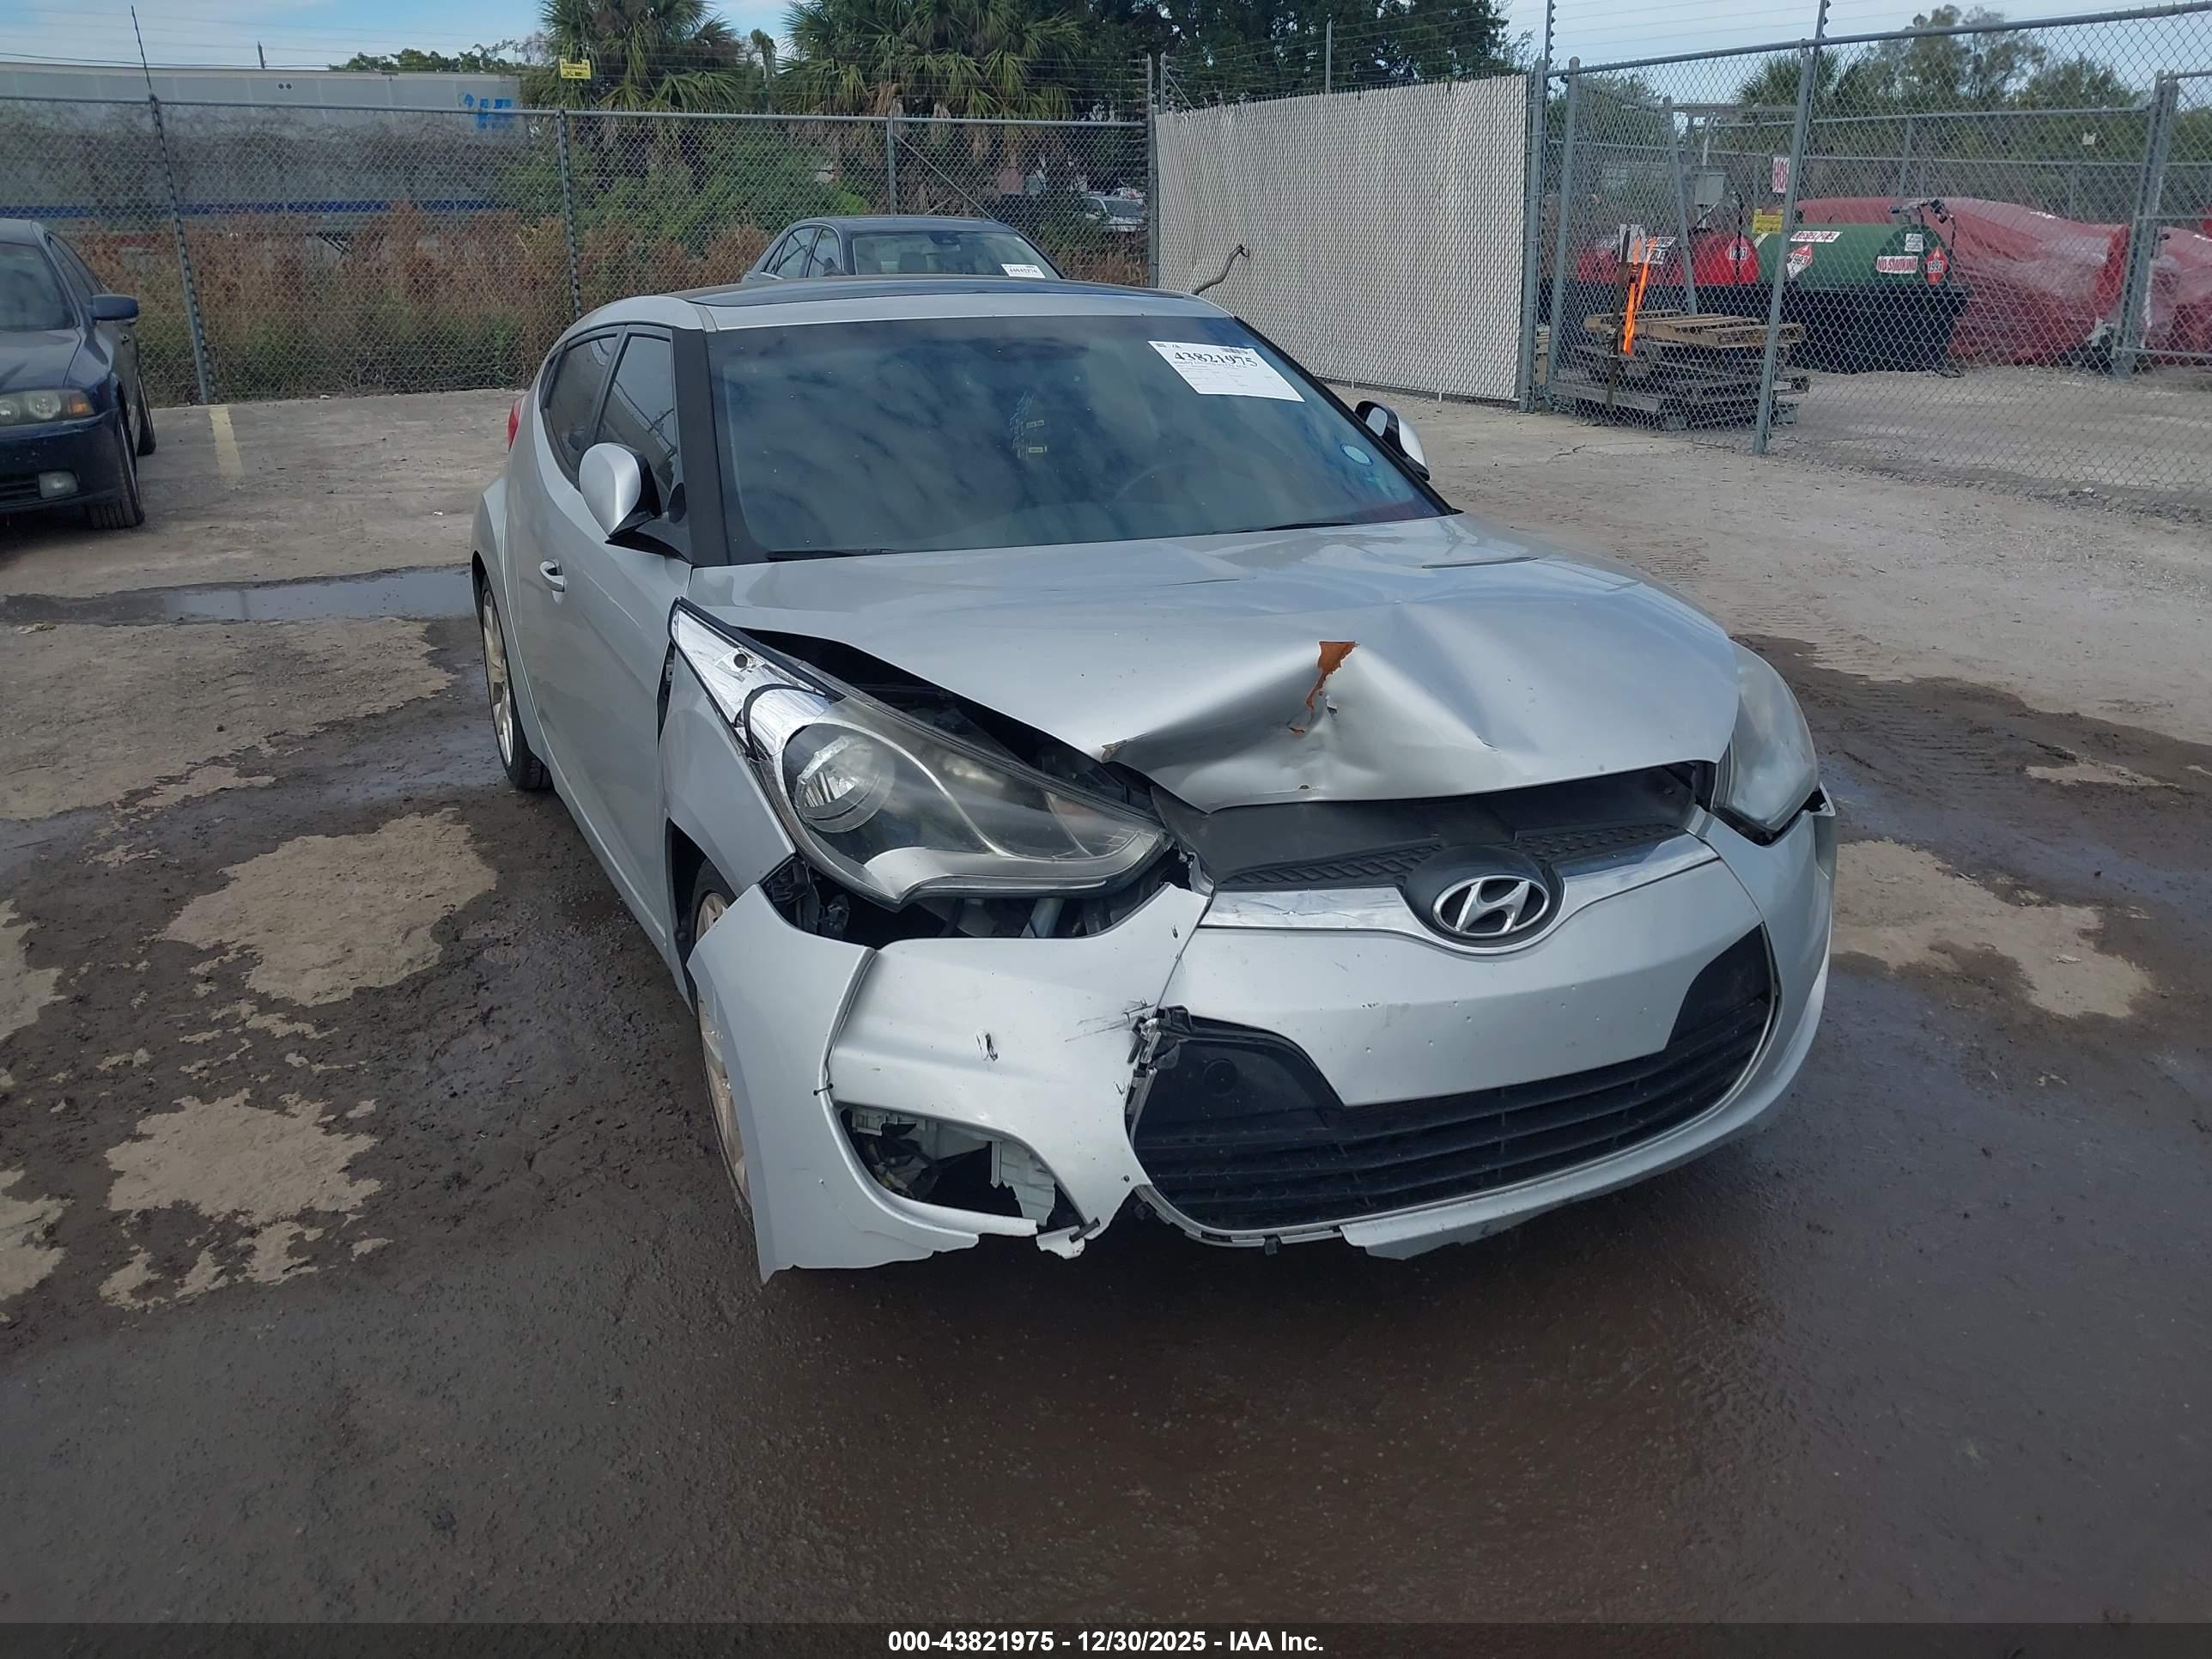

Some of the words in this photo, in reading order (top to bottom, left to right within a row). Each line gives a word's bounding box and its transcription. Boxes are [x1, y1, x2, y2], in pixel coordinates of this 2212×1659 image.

[1878, 258, 1887, 270] NO
[1888, 258, 1917, 271] SMOKING
[1175, 352, 1258, 368] 43821975
